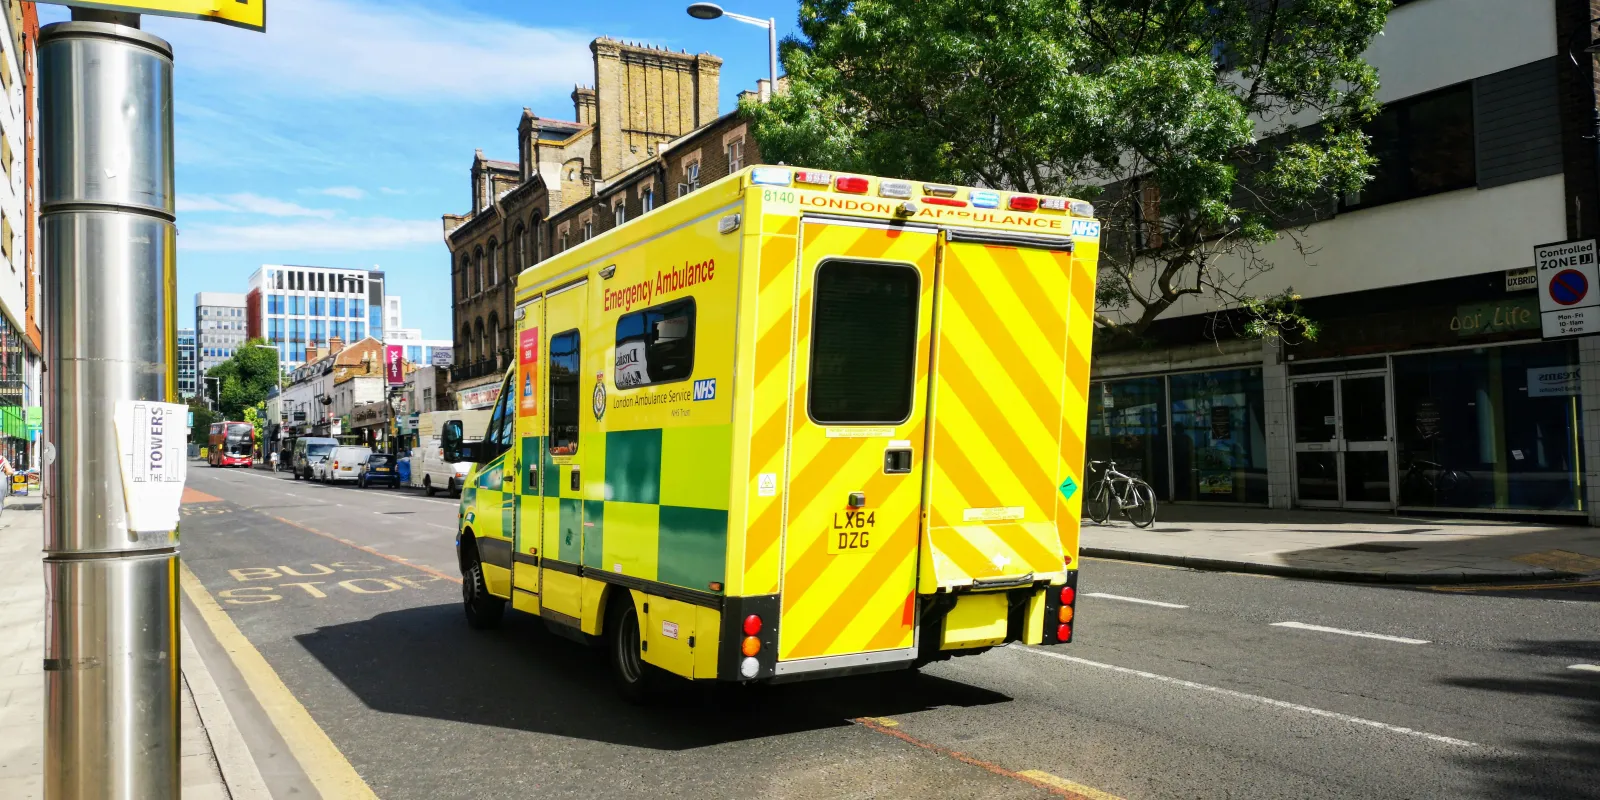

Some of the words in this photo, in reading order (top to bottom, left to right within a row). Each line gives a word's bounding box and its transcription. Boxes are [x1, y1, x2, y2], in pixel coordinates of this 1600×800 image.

[764, 189, 795, 204] 8140
[800, 195, 891, 214] LONDON
[1072, 219, 1100, 238] NHS
[1540, 243, 1593, 258] Controlled
[1540, 256, 1578, 270] ZONE
[604, 279, 654, 312] Emergency
[655, 258, 715, 296] Ambulance
[1507, 275, 1537, 287] UXBRID
[1493, 306, 1532, 326] Life
[613, 396, 634, 409] London
[635, 391, 668, 406] Ambulance
[669, 388, 691, 403] Service
[694, 379, 716, 400] NHS
[671, 409, 680, 417] NHS
[680, 408, 691, 417] Trust
[150, 406, 164, 471] TOWERS
[149, 473, 163, 482] THE
[833, 511, 876, 529] LX64
[838, 531, 870, 549] DZG
[228, 561, 386, 582] BUS
[218, 574, 442, 605] STOP
